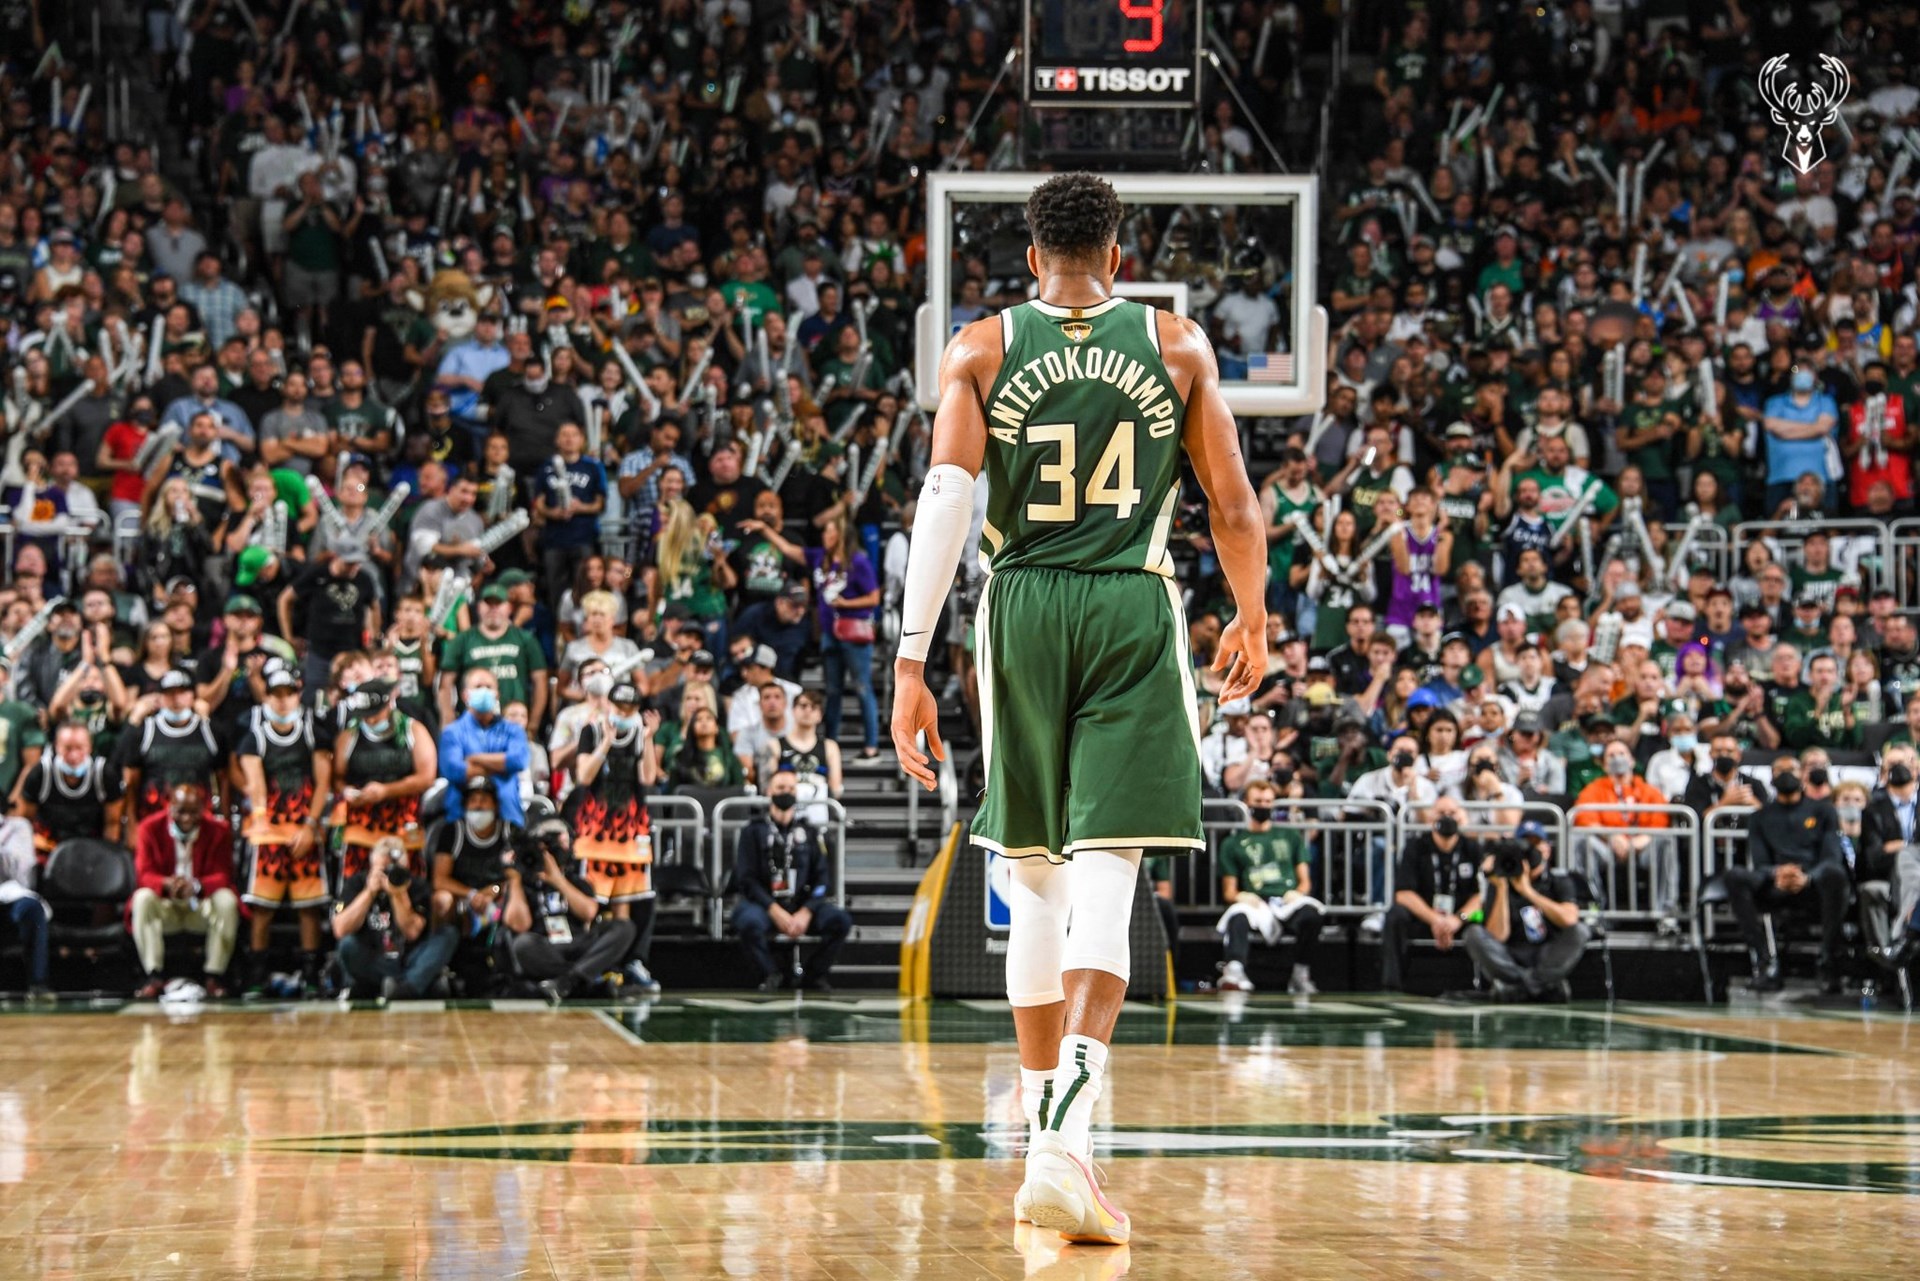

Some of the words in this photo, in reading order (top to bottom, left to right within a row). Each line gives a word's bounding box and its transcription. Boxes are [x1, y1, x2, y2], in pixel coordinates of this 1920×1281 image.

[1078, 67, 1191, 92] TISSOT
[989, 346, 1176, 446] ANTETOKOUNMPO
[1026, 421, 1141, 522] 34
[1328, 585, 1354, 609] 34
